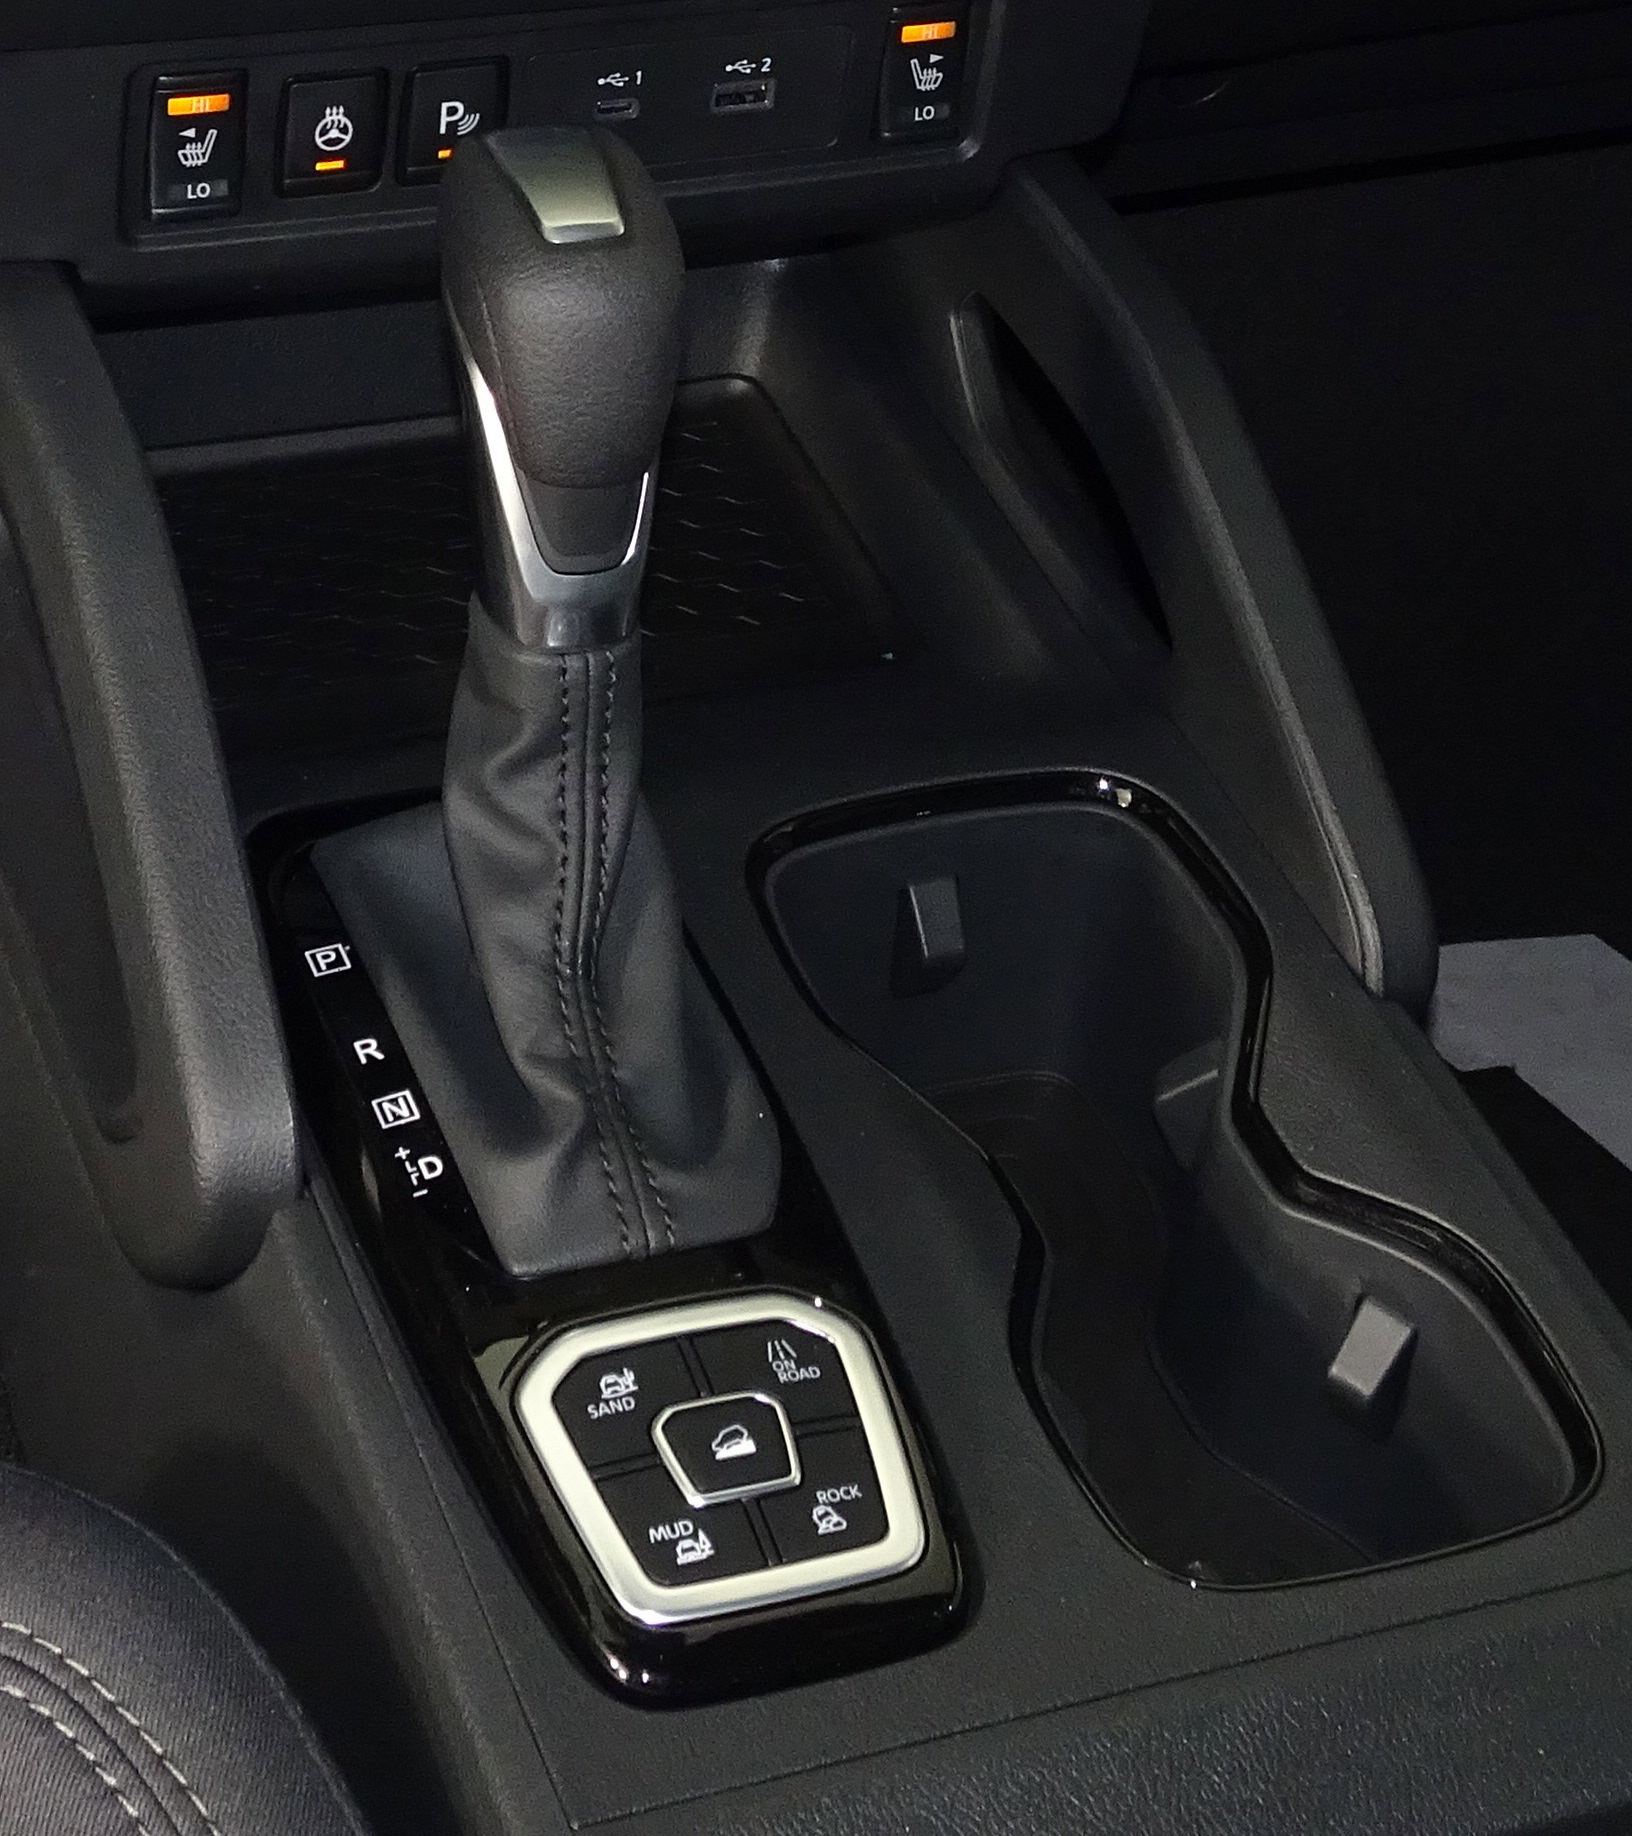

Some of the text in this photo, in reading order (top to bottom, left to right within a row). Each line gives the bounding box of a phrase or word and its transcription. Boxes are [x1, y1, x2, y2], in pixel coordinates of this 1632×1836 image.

[761, 57, 772, 72] 2
[914, 105, 935, 121] LO
[187, 182, 211, 199] LO
[315, 950, 336, 971] P
[353, 1038, 385, 1064] R
[381, 1097, 410, 1123] N
[418, 1155, 444, 1180] D
[772, 1360, 796, 1372] ON
[778, 1365, 821, 1384] ROAD
[587, 1396, 636, 1420] SAND
[816, 1484, 862, 1505] ROCK
[649, 1520, 694, 1544] MUD
